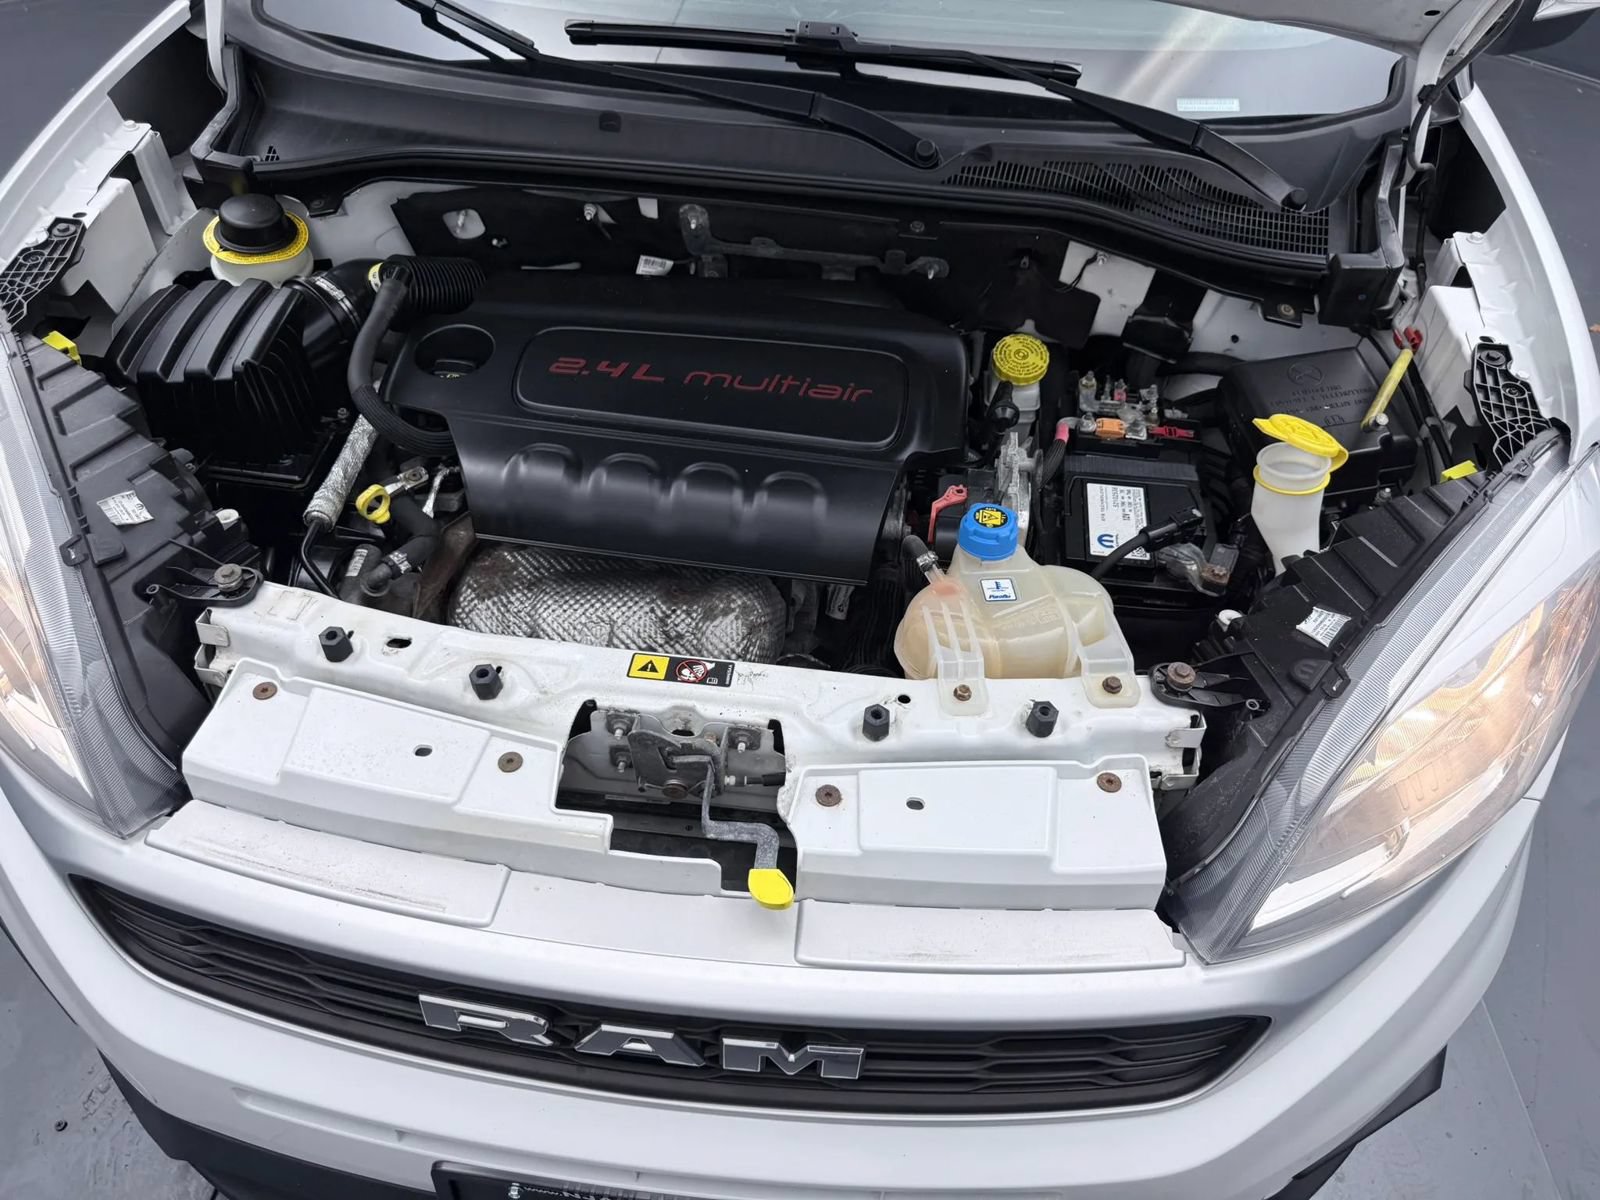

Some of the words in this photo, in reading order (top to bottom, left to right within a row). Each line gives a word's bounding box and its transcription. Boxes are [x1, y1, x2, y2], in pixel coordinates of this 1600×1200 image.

[548, 356, 665, 382] 2.4L
[683, 371, 873, 402] multiair
[418, 993, 866, 1080] RAM
